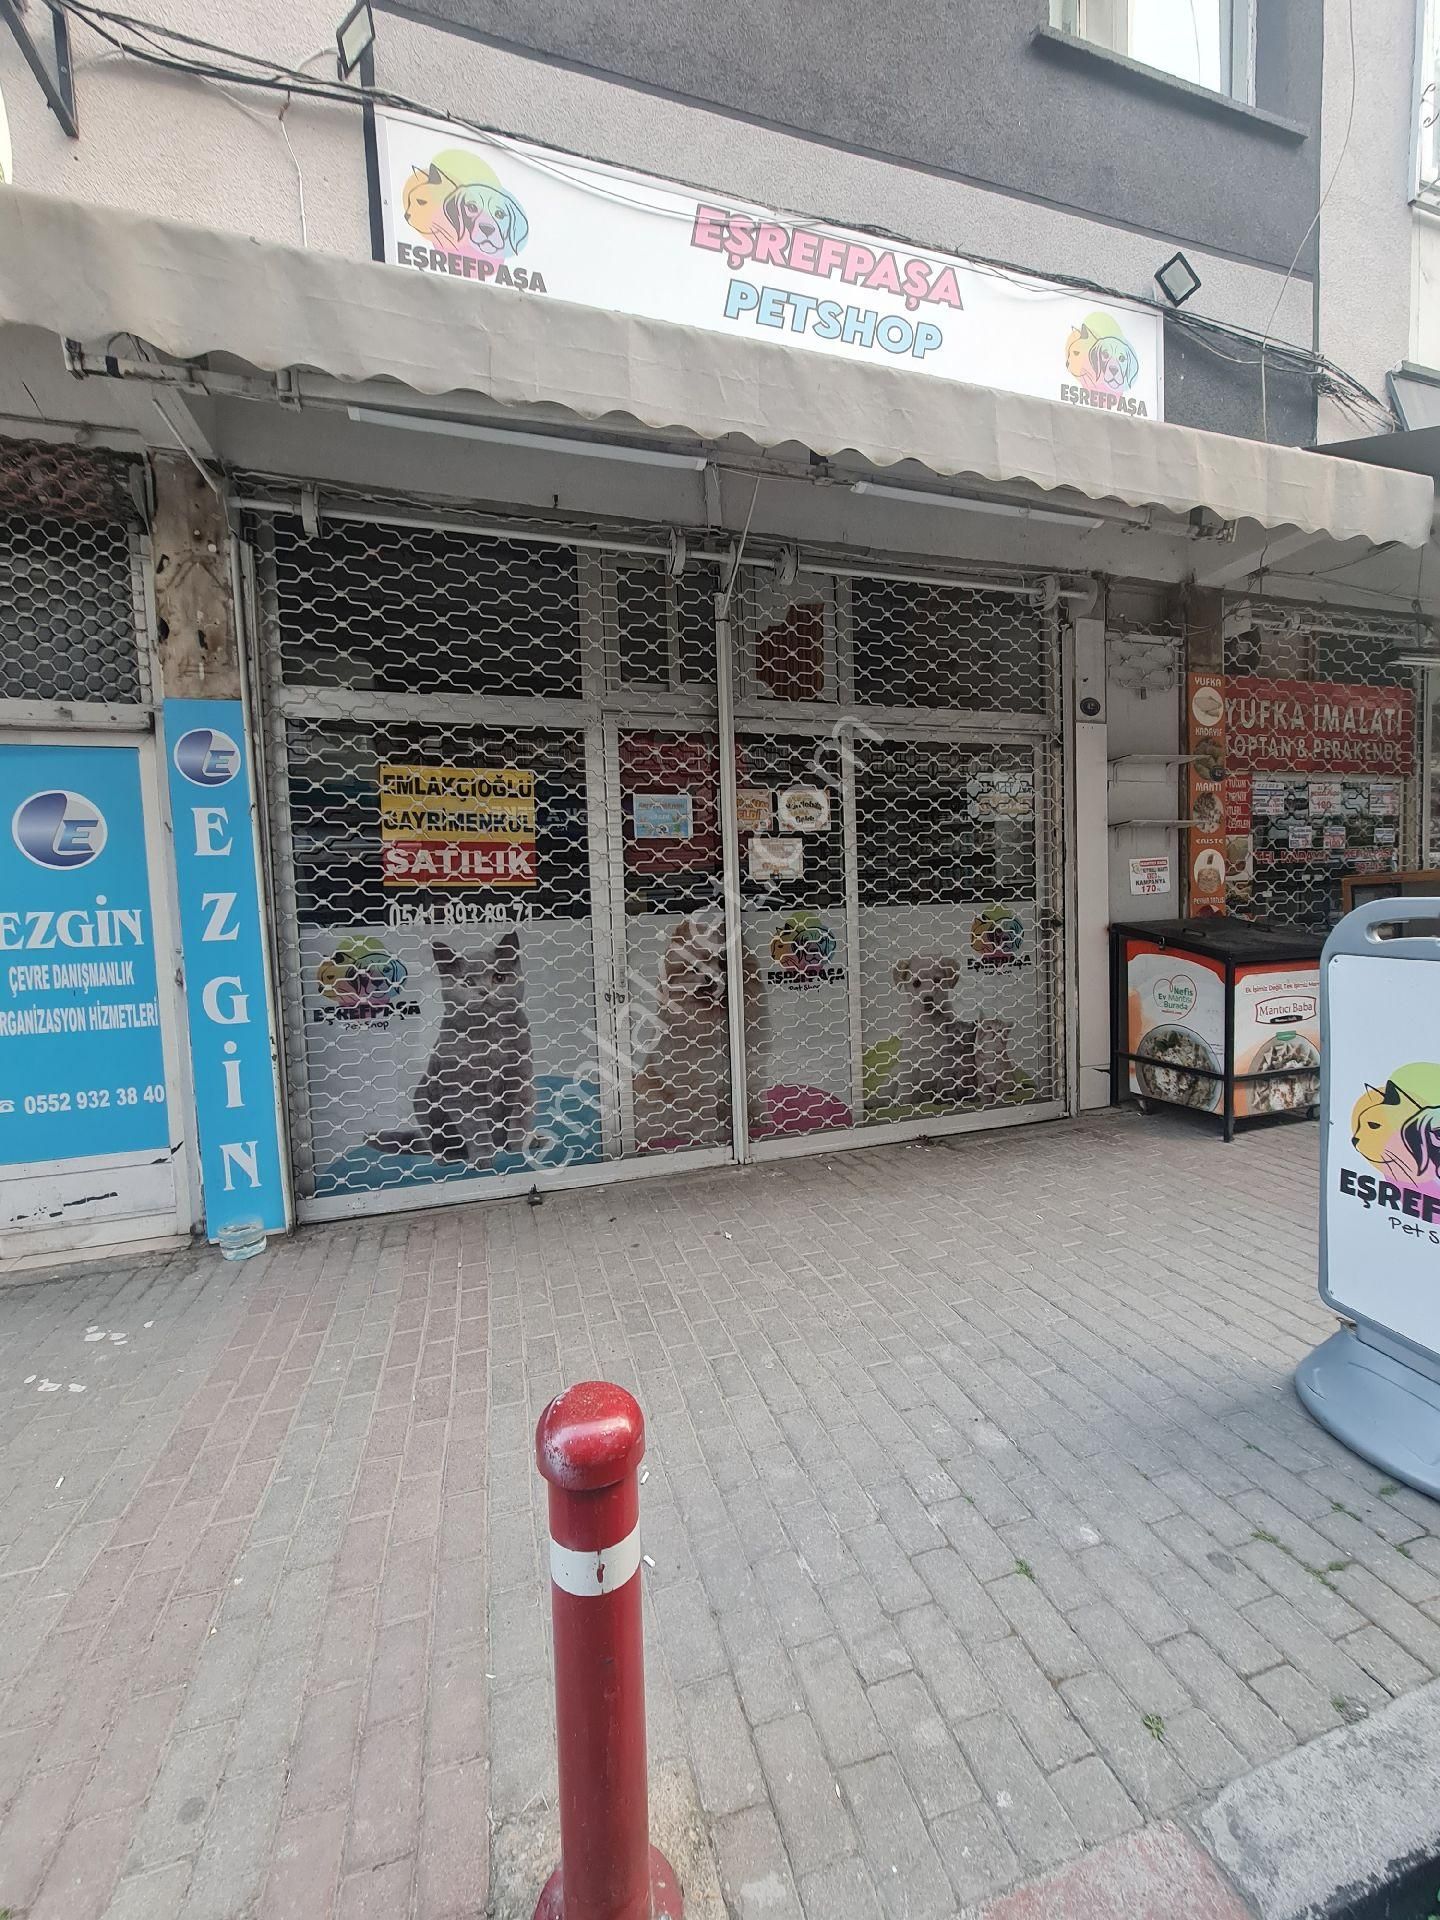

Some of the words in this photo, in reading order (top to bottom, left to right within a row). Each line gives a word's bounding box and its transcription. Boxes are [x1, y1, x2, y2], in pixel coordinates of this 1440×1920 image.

[690, 203, 964, 311] EŞREFPAŞA
[723, 278, 943, 360] PETSHOP
[1060, 384, 1148, 418] EŞREFPAŞA
[1194, 677, 1221, 687] YUFKA
[1225, 697, 1305, 731] YUFKA
[1196, 783, 1221, 791] MANTI
[386, 848, 534, 874] SATILIK
[1142, 885, 1156, 893] 170
[0, 895, 144, 950] EZGİN
[8, 965, 50, 998] ÇEVRE
[53, 961, 135, 994] DANIŞMANLIK
[1174, 987, 1193, 997] Nefis
[89, 996, 159, 1030] HİZMETLERİ
[191, 807, 262, 1191] EZGİN
[1163, 1002, 1188, 1010] Burada
[1293, 1002, 1313, 1012] Baba
[24, 1093, 71, 1114] 0552
[76, 1090, 110, 1109] 932
[116, 1087, 137, 1106] 38
[143, 1085, 164, 1103] 40
[1388, 1217, 1425, 1237] Pet
